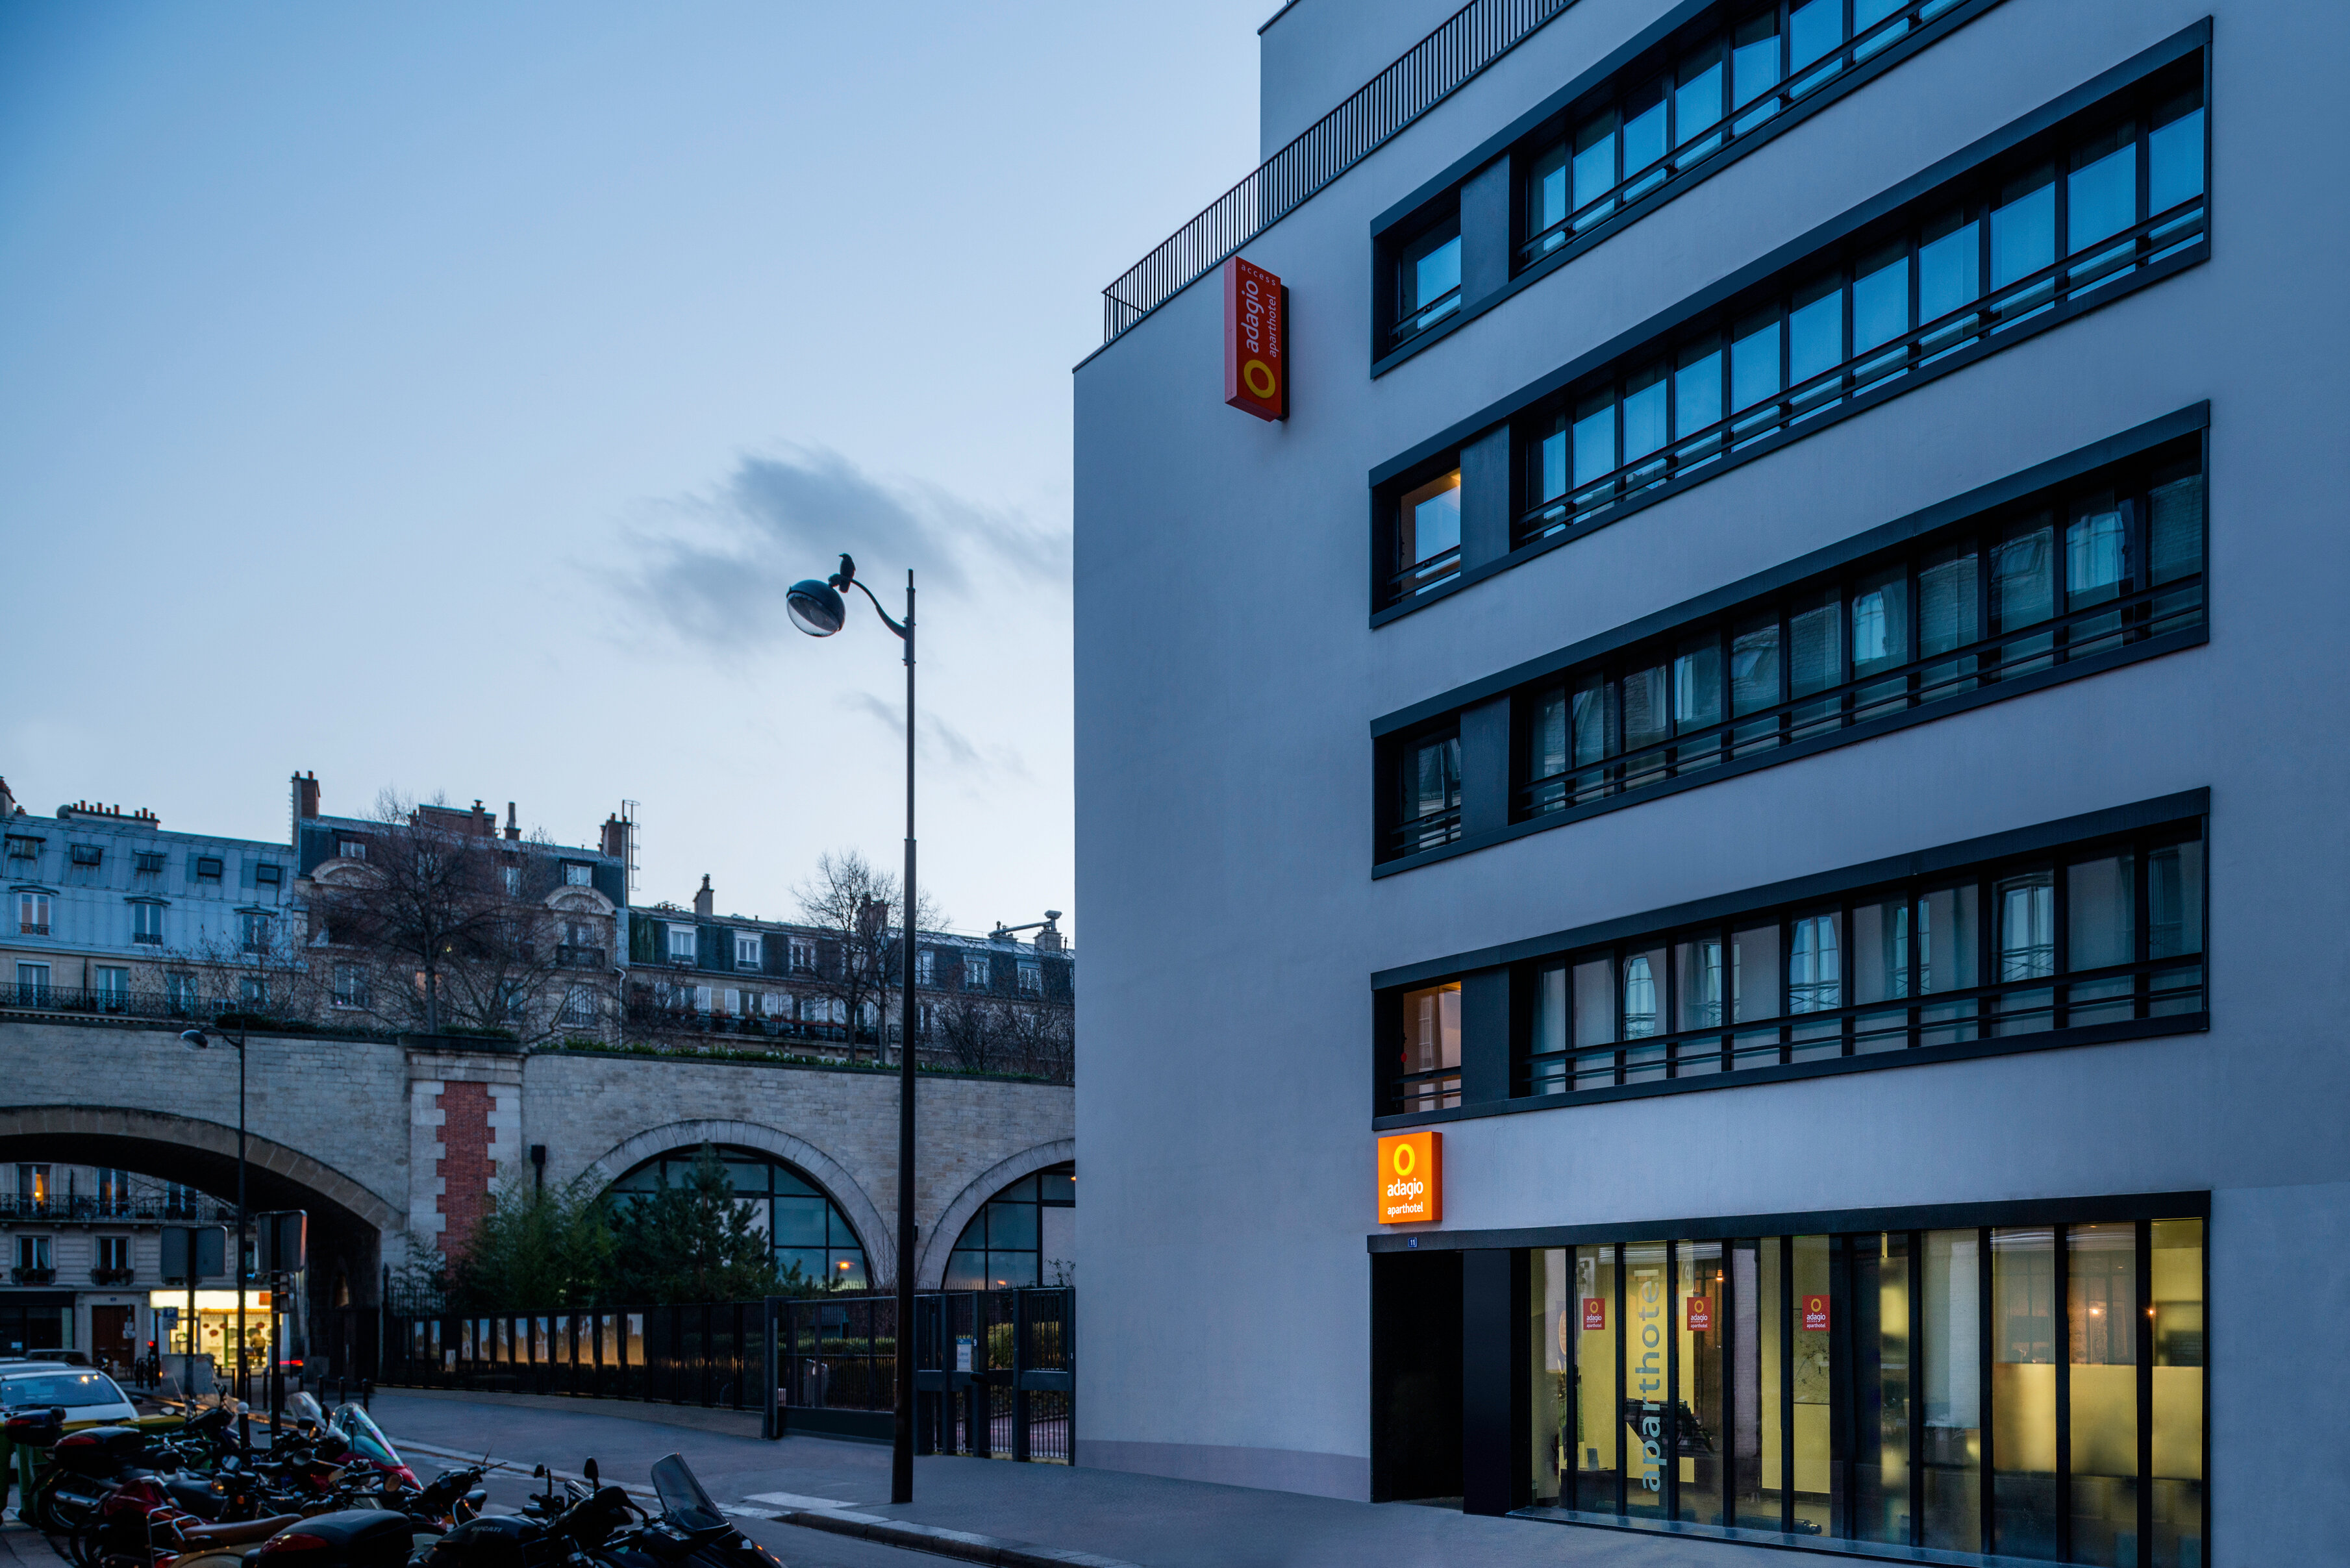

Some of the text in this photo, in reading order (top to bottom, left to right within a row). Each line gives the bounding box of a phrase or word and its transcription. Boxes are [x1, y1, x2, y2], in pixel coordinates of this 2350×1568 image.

[1241, 264, 1276, 286] access
[1241, 280, 1264, 353] adagio
[1266, 293, 1279, 358] aparthotel
[1387, 1178, 1423, 1200] adagio
[1387, 1202, 1423, 1217] aparthotel
[1586, 1313, 1602, 1323] adagio
[1690, 1313, 1708, 1323] adagio
[1806, 1312, 1826, 1323] adagio
[973, 1338, 977, 1347] 9
[1634, 1269, 1667, 1492] aparthotel
